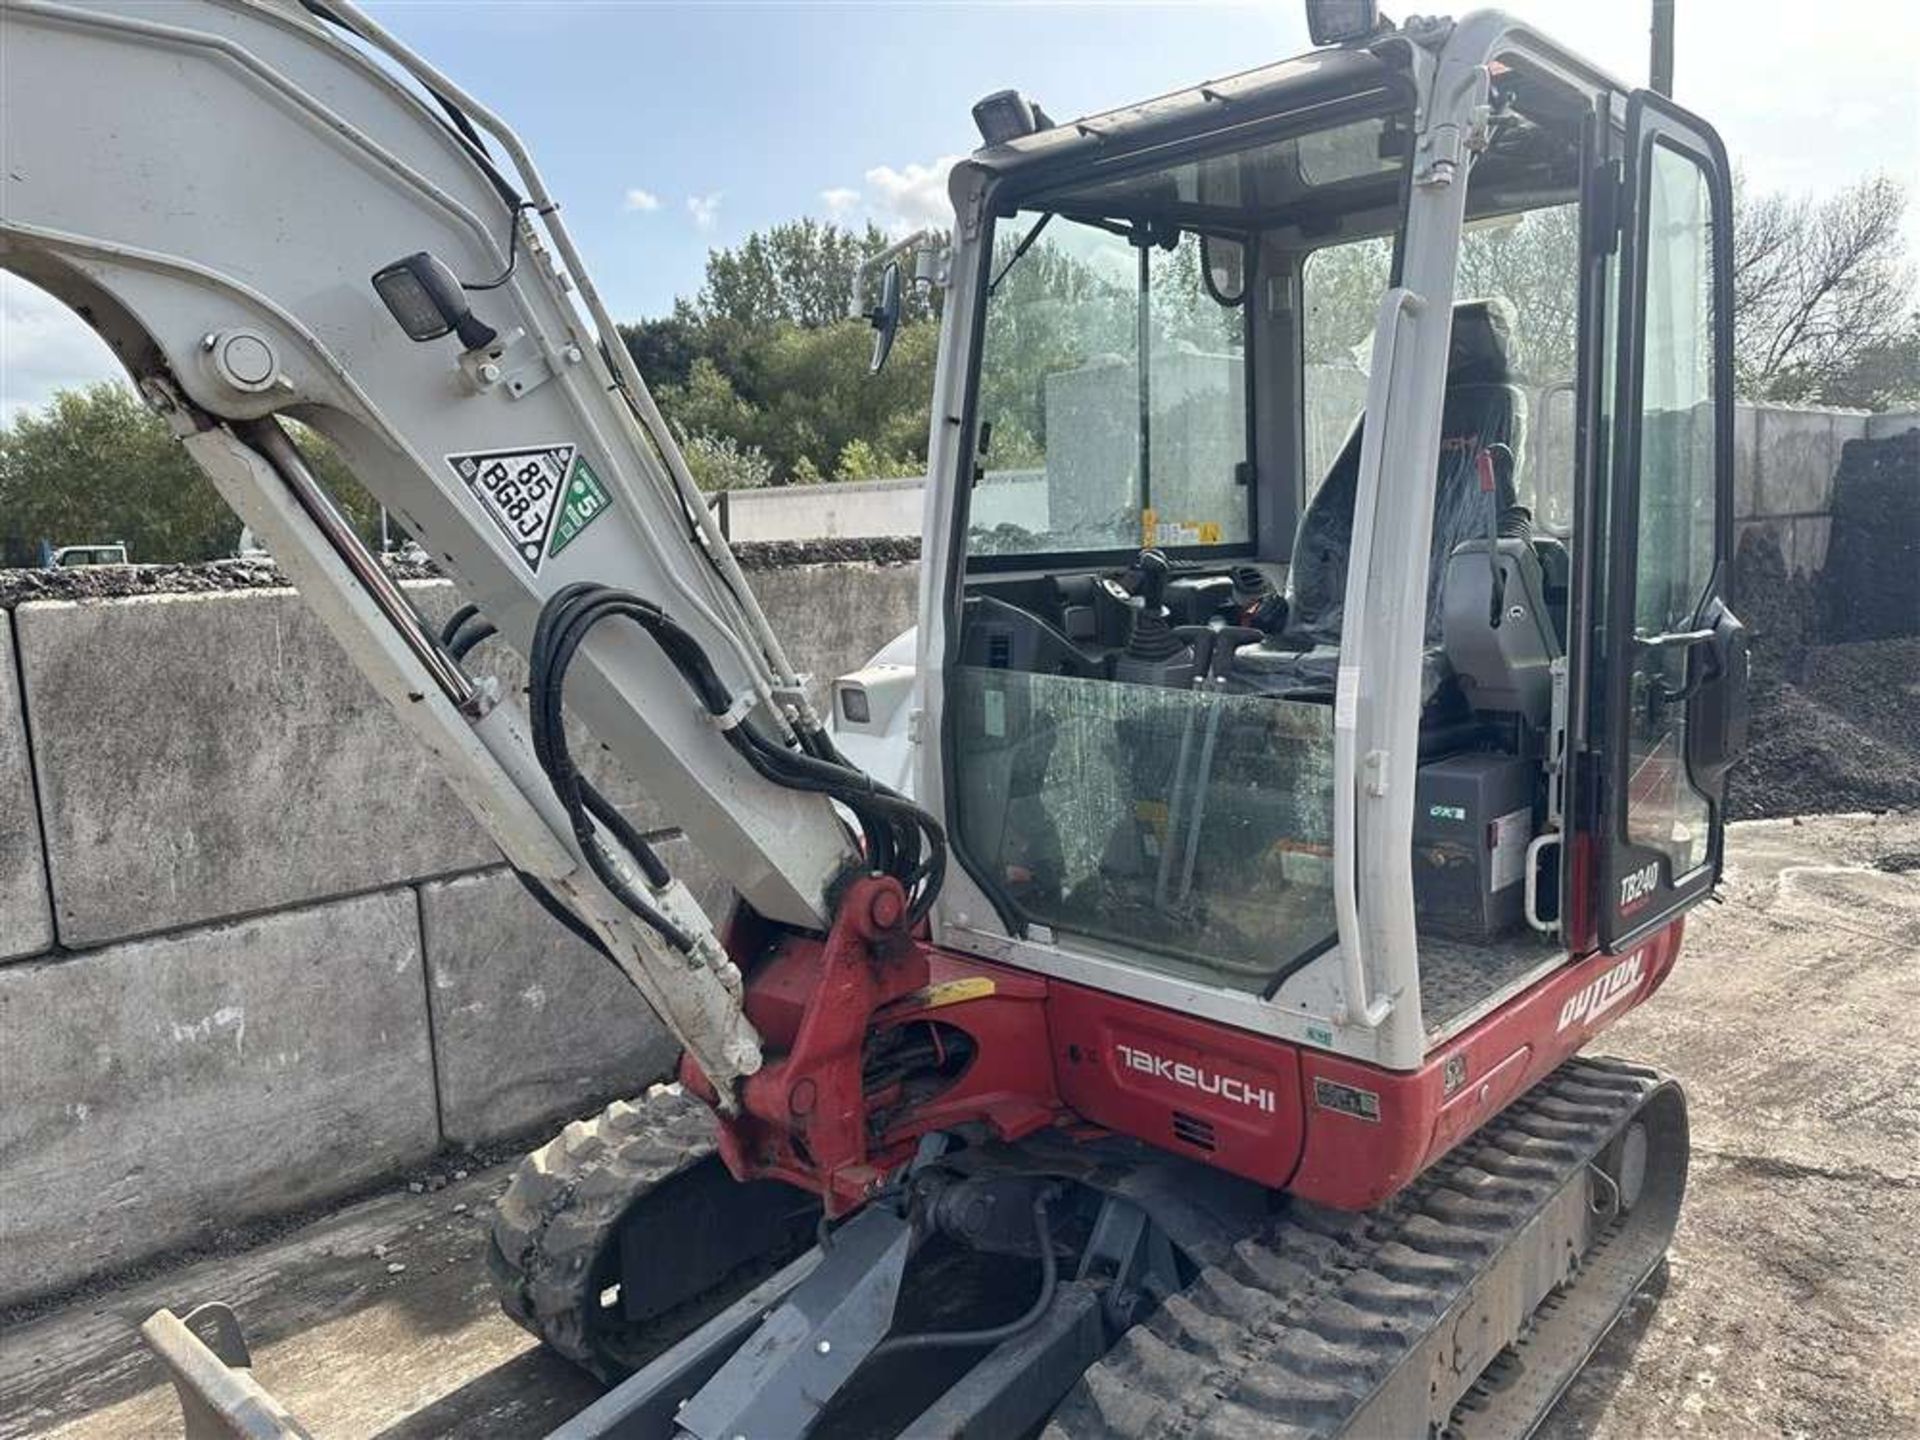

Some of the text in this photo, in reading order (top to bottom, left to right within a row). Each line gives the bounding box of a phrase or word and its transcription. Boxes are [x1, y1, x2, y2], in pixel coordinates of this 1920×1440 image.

[482, 462, 543, 537] BG8J
[517, 461, 553, 501] 85
[577, 495, 598, 517] 5
[1620, 861, 1659, 907] TB240
[1556, 948, 1646, 1032] DUTTON
[1116, 1044, 1275, 1113] TAKEUCHI
